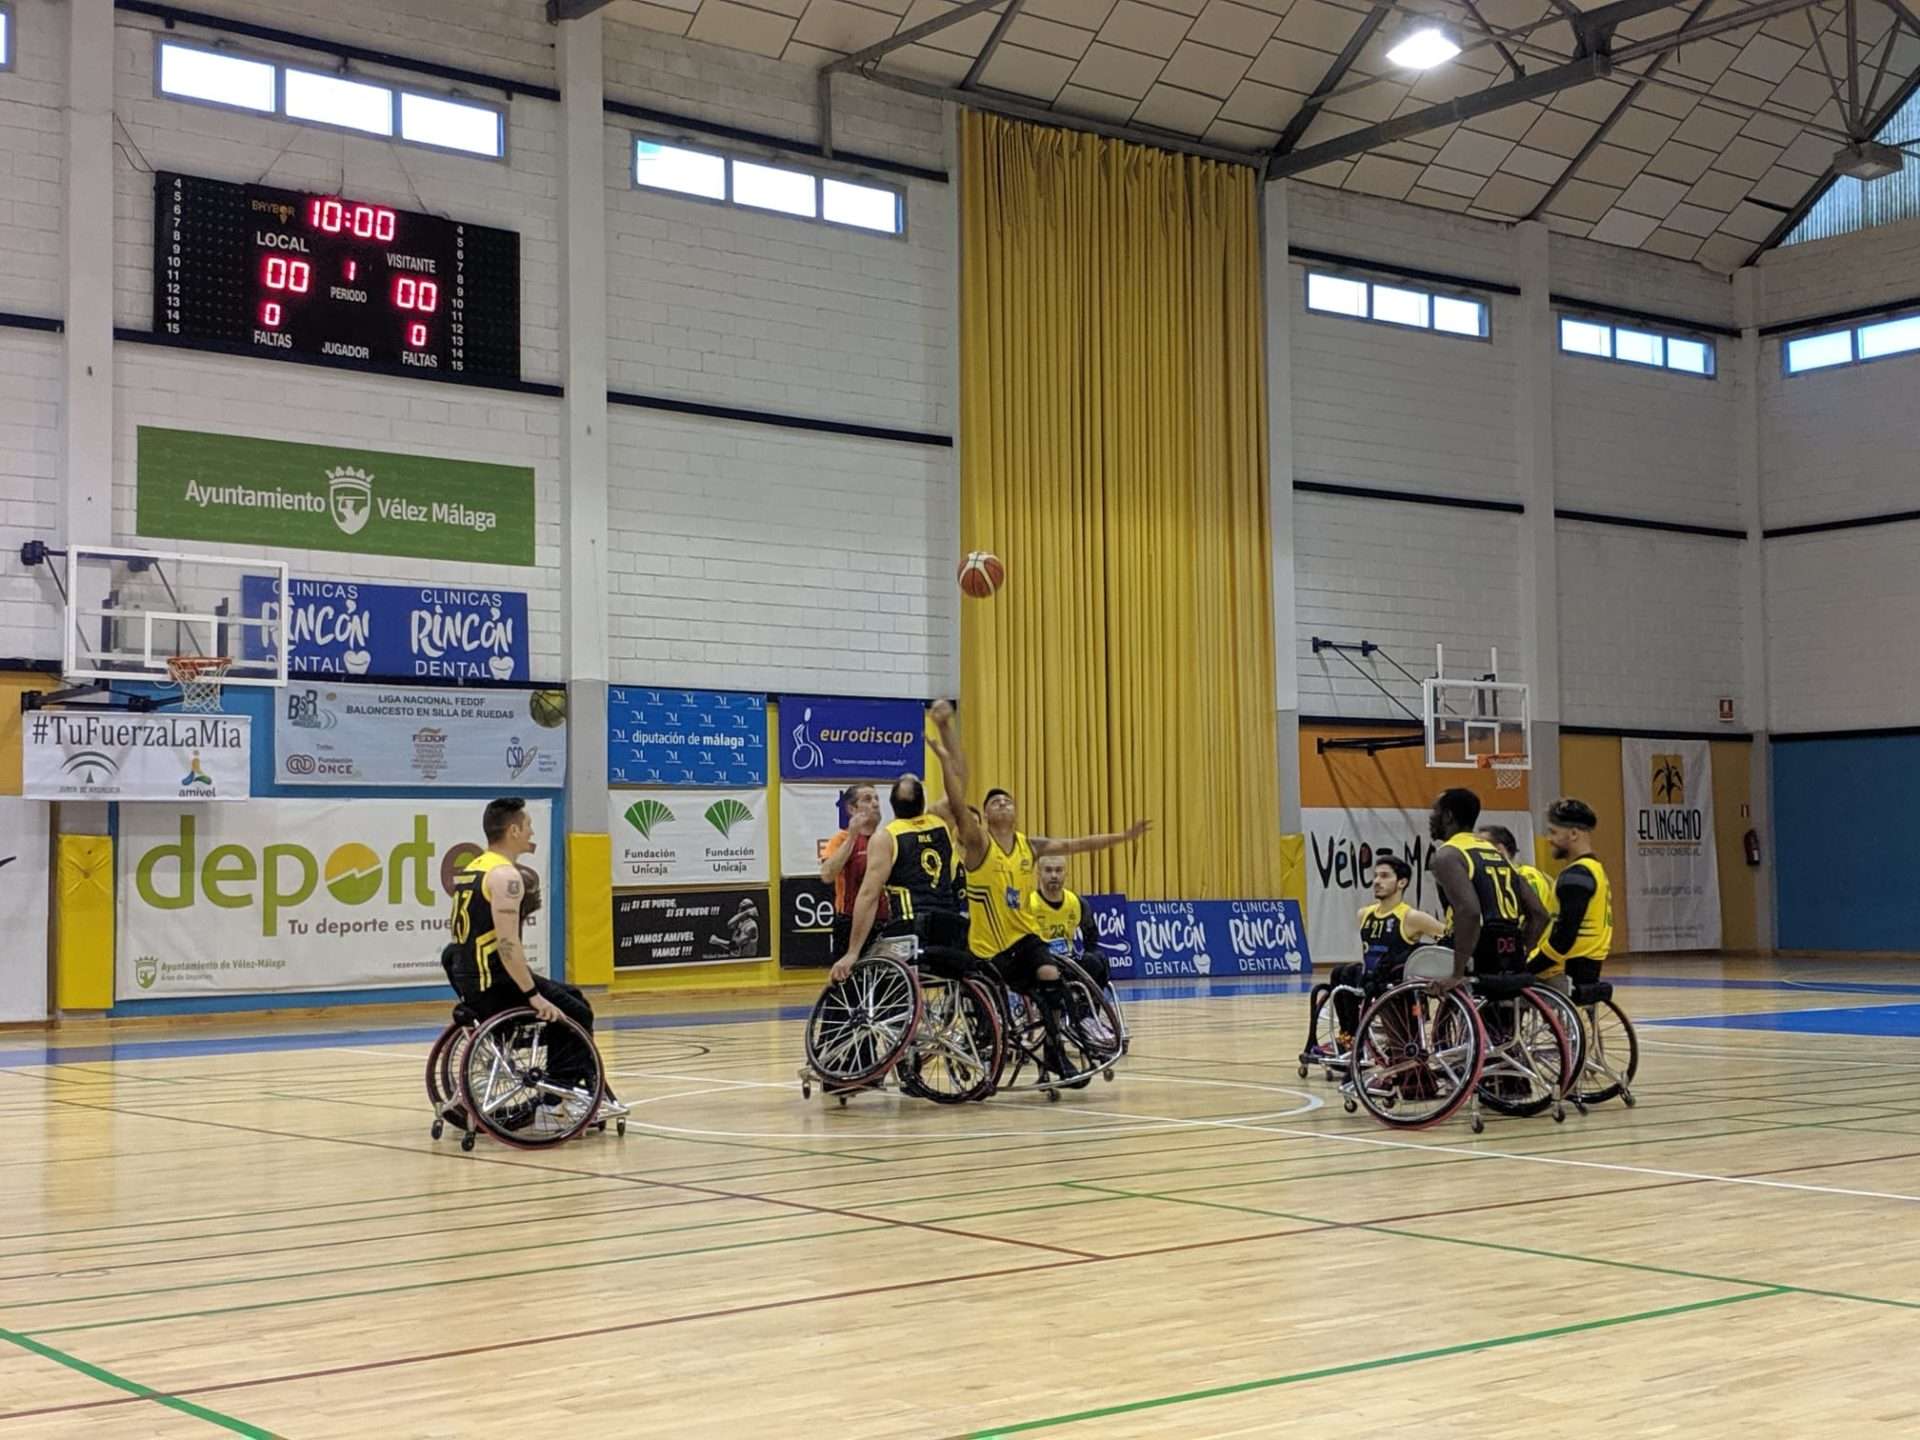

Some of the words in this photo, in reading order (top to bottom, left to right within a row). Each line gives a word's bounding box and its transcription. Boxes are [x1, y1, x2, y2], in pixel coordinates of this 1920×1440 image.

[174, 178, 182, 188] 4
[174, 192, 181, 202] 5
[174, 205, 181, 214] 6
[174, 218, 181, 227] 7
[312, 201, 395, 241] 10:00
[456, 226, 464, 234] 4
[173, 231, 181, 241] 8
[256, 231, 309, 253] LOCAL
[457, 238, 464, 247] 5
[173, 244, 180, 254] 9
[457, 250, 464, 260] 6
[167, 257, 181, 267] 10
[387, 253, 436, 273] VISITANTE
[457, 263, 464, 272] 7
[167, 270, 179, 280] 11
[266, 257, 310, 293] 00
[348, 261, 356, 281] 1
[457, 275, 464, 285] 8
[167, 283, 180, 294] 12
[457, 287, 464, 297] 9
[330, 286, 368, 303] PERIODO
[397, 278, 437, 312] 00
[167, 296, 180, 307] 13
[451, 299, 464, 309] 10
[166, 310, 180, 320] 14
[264, 303, 281, 326] 0
[451, 311, 463, 321] 11
[166, 323, 180, 334] 15
[451, 324, 464, 334] 12
[254, 330, 292, 348] FALTAS
[412, 324, 426, 346] 0
[451, 336, 464, 345] 13
[321, 342, 369, 359] JUGADOR
[451, 349, 464, 358] 14
[402, 351, 438, 368] FALTAS
[451, 361, 464, 370] 15
[185, 479, 326, 514] Ayuntamiento
[376, 497, 428, 522] Vélez
[431, 502, 496, 532] Málaga
[420, 589, 502, 607] CLINICAS
[415, 660, 491, 678] DENTAL
[378, 695, 397, 704] LIGA
[403, 696, 453, 705] NACIONAL
[346, 705, 414, 716] BALONCESTO
[416, 708, 430, 716] EN
[432, 708, 459, 718] SILLA
[461, 709, 474, 718] DE
[476, 710, 514, 719] RUEDAS
[32, 716, 242, 748] #TuFuerzaLaMia
[819, 727, 914, 747] eurodiscap
[632, 730, 685, 746] diputación
[688, 732, 700, 745] de
[703, 733, 744, 749] málaga
[318, 764, 352, 774] ONCE
[178, 787, 217, 798] amivel
[1638, 809, 1654, 840] EL
[1655, 809, 1701, 840] INGENIO
[624, 849, 676, 859] Fundación
[705, 847, 754, 857] Fundación
[632, 863, 668, 876] Unicaja
[713, 862, 747, 874] Unicaja
[921, 848, 942, 889] 9
[631, 900, 640, 910] SI
[641, 900, 650, 909] SE
[1140, 902, 1194, 915] CLINICAS
[1232, 901, 1285, 913] CLINICAS
[665, 908, 674, 917] SI
[675, 908, 684, 917] SE
[685, 906, 709, 917] PUEDE
[288, 919, 308, 934] Tu
[316, 917, 388, 937] deporte
[395, 918, 415, 931] es
[634, 933, 663, 945] VAMOS
[663, 931, 695, 942] AMIVEL
[651, 947, 681, 958] VAMOS
[1145, 960, 1196, 975] DENTAL
[1239, 957, 1288, 971] DENTAL
